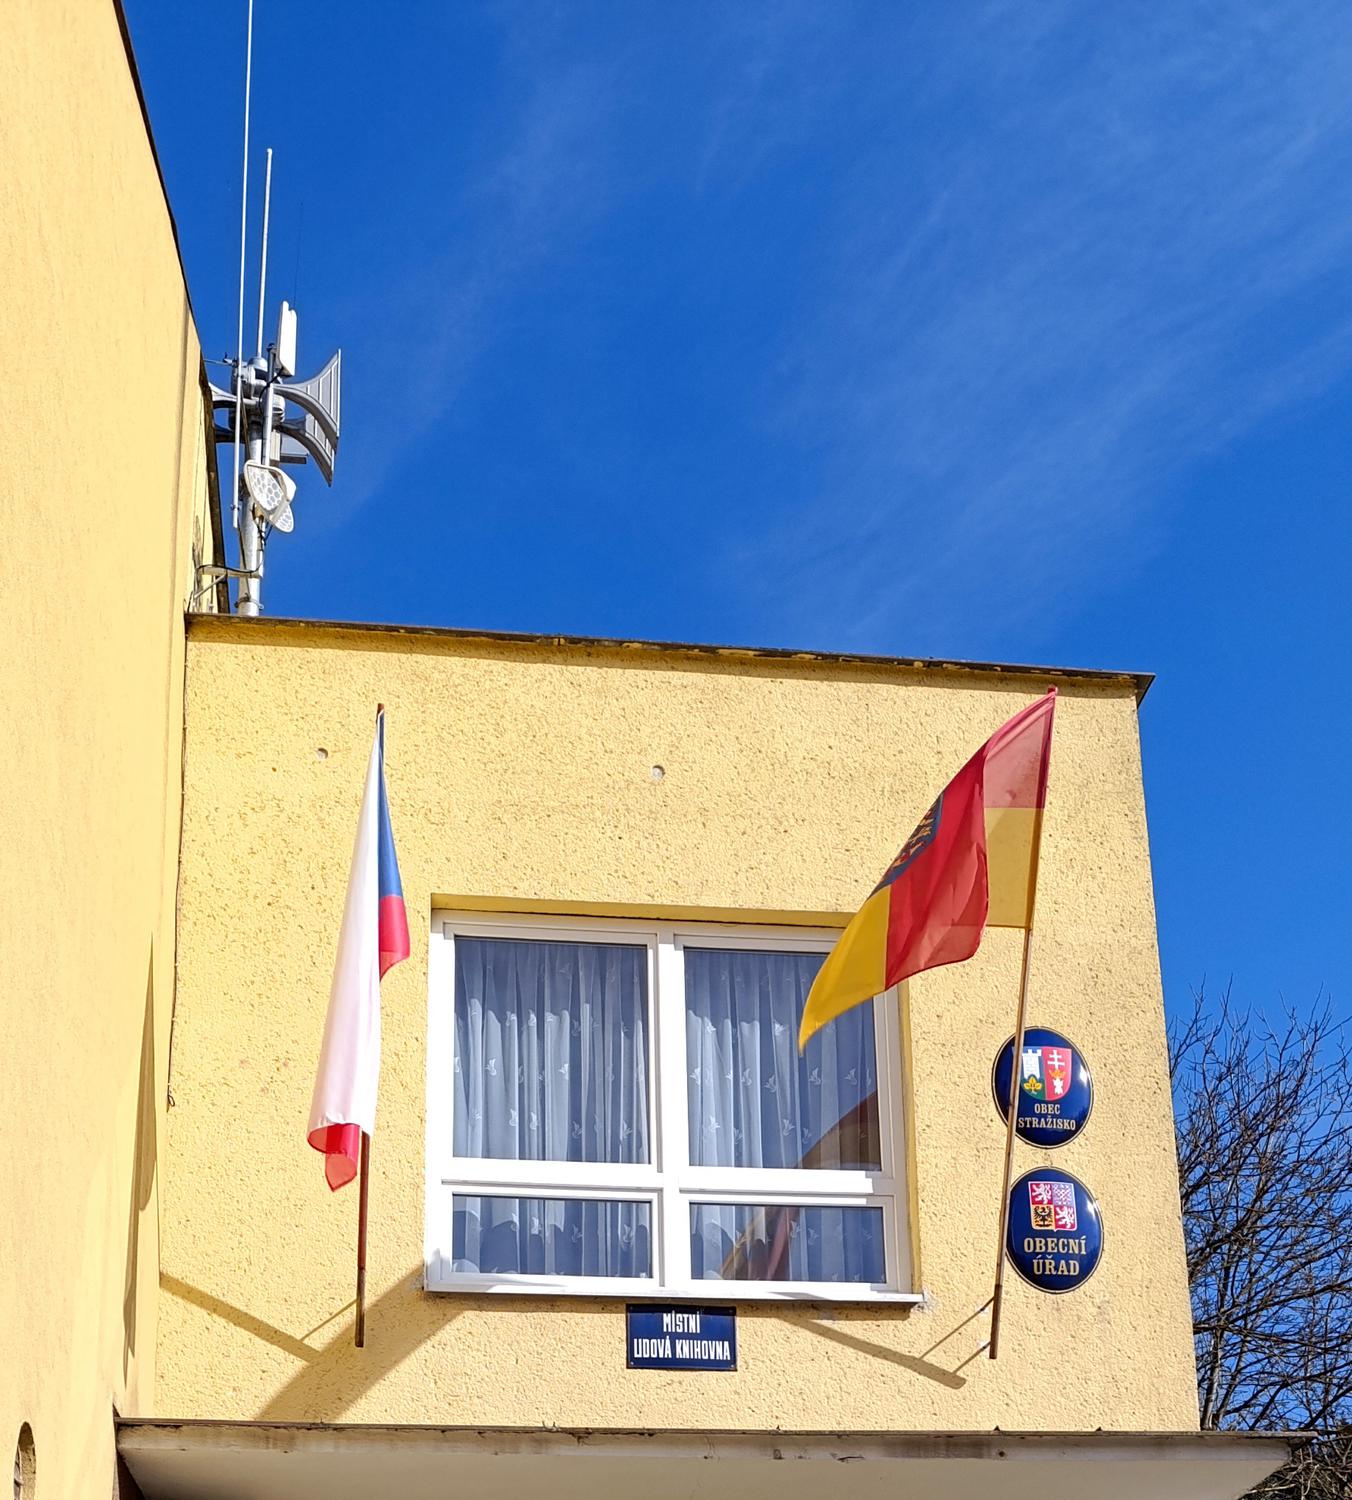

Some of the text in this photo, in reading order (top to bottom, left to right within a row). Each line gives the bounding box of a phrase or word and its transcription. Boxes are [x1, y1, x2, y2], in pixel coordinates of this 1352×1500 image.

[1034, 1103, 1061, 1115] OBEC
[1018, 1114, 1076, 1131] STRAŽISKO
[1023, 1235, 1087, 1255] OBECNÍ
[1032, 1255, 1080, 1276] ÚŘAD
[663, 1310, 700, 1333] MÍSTNÍ
[634, 1335, 731, 1360] LIDOVÁ KNIHOVNA
